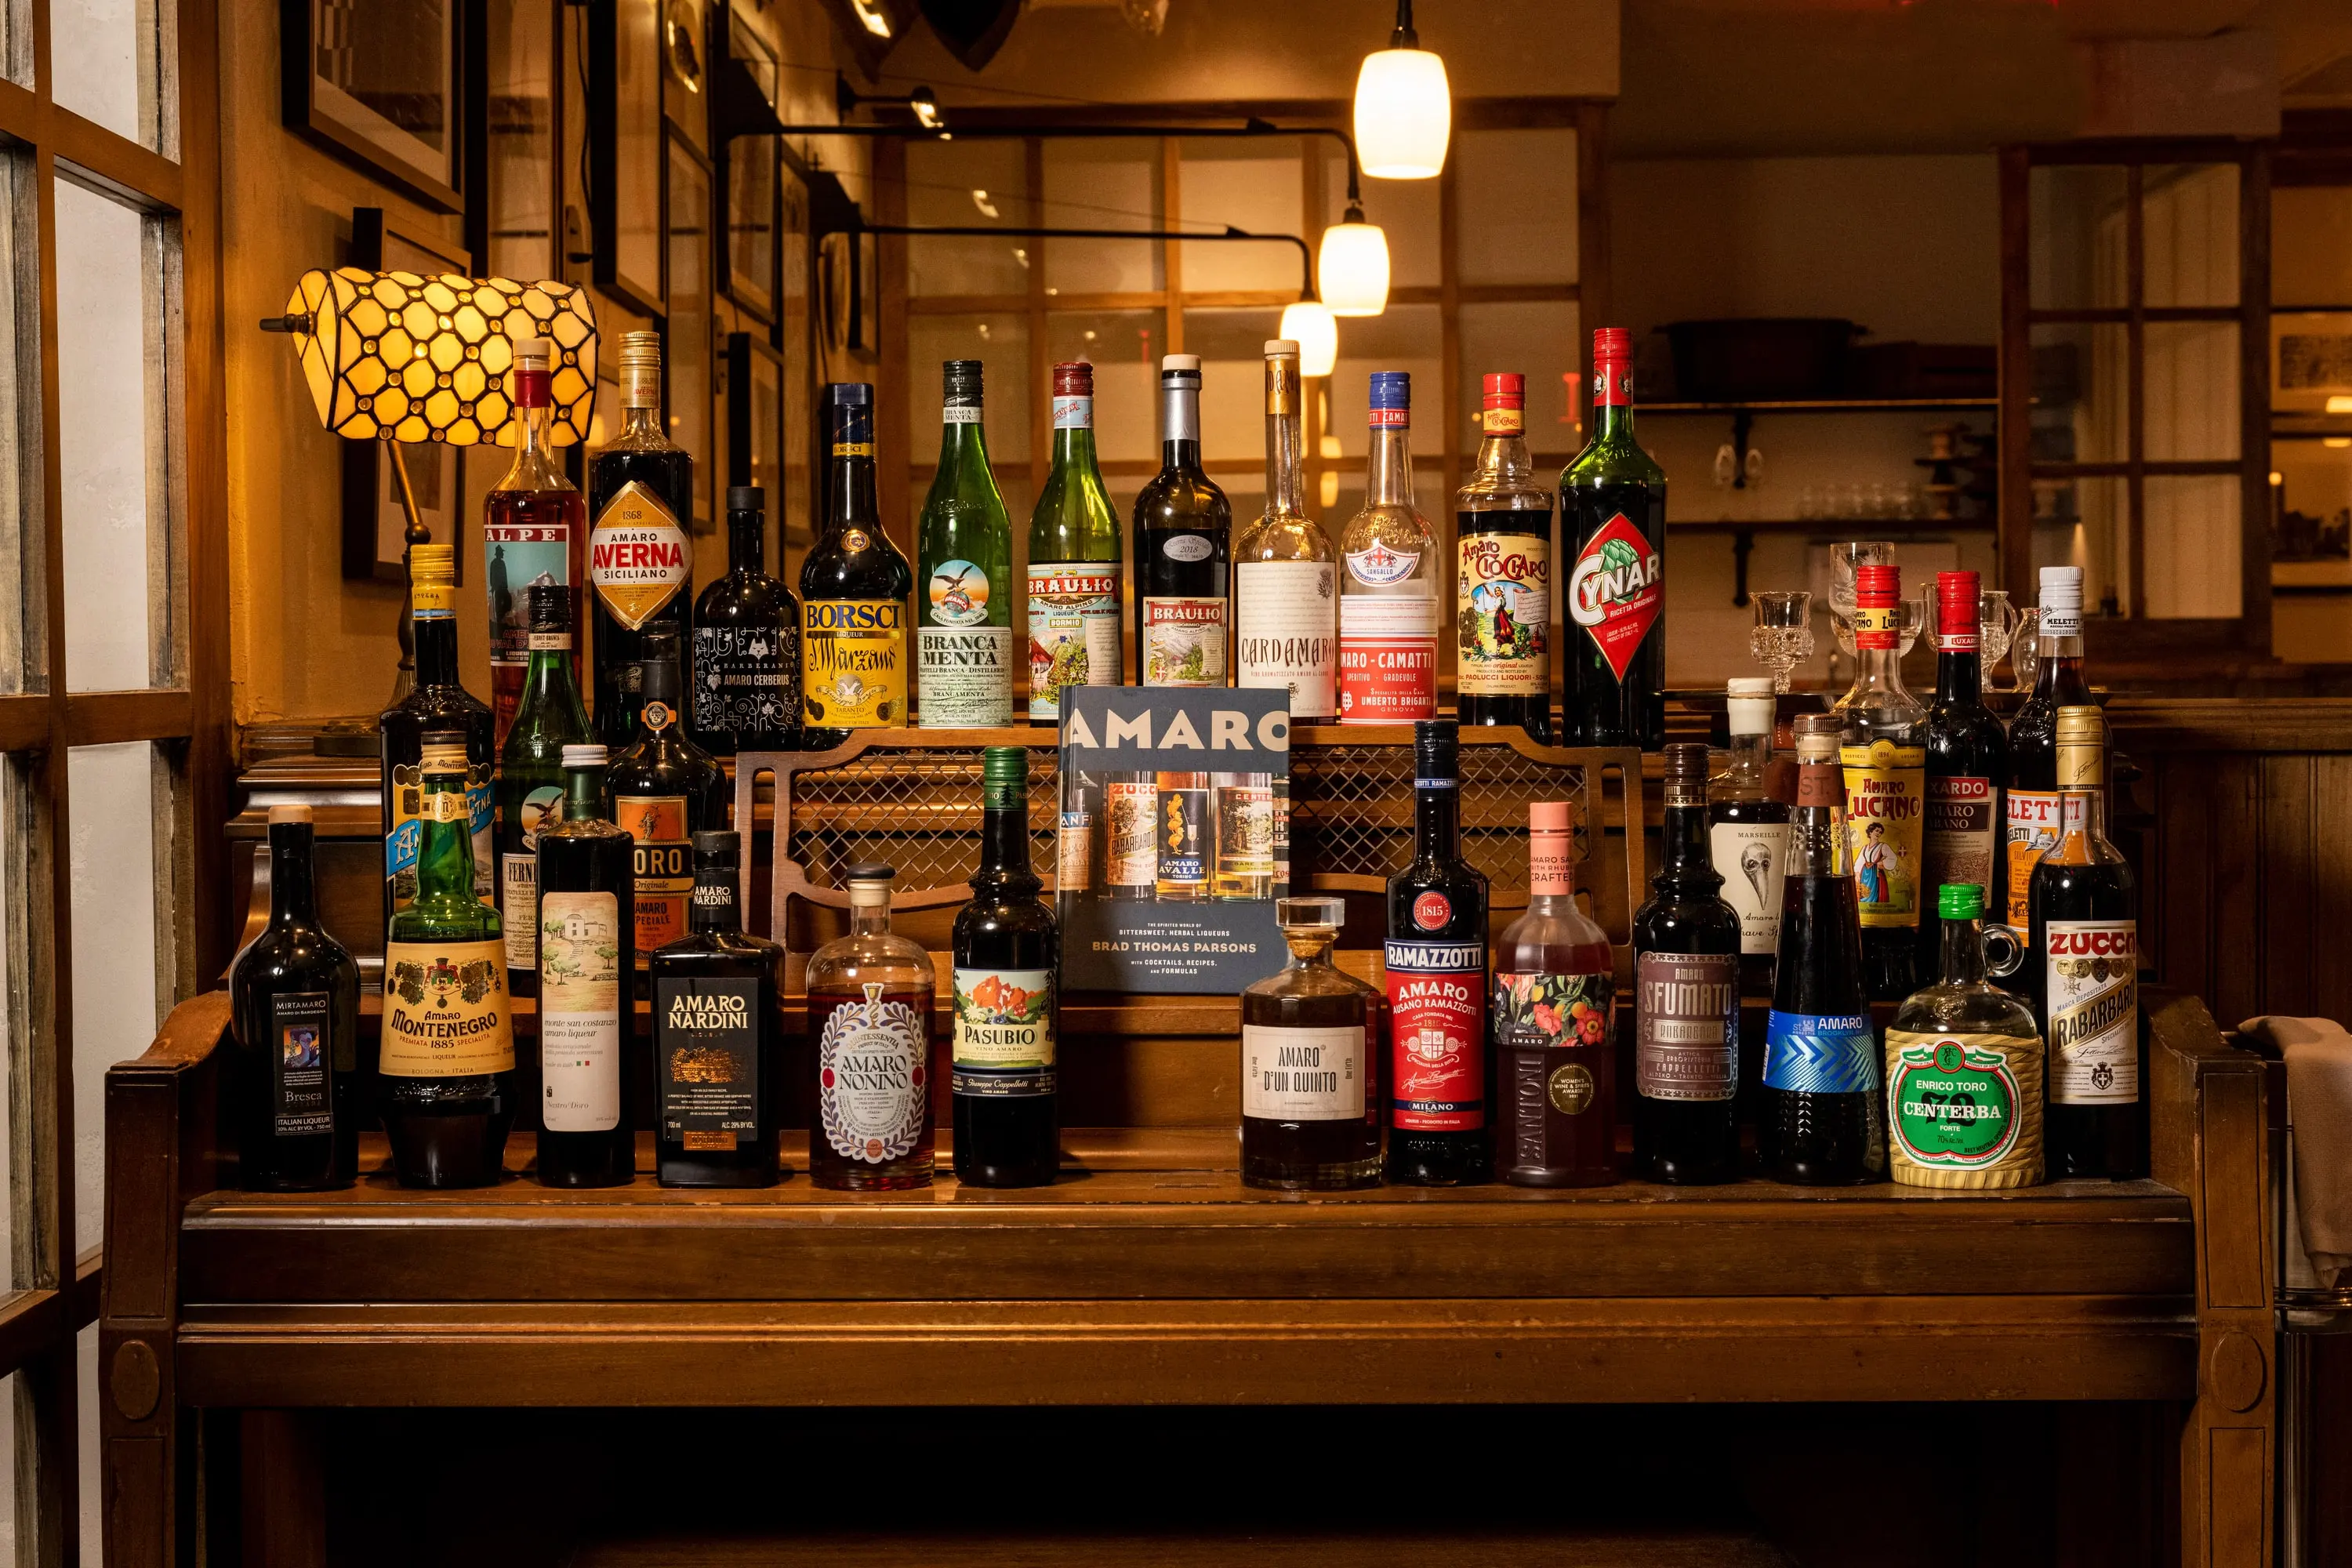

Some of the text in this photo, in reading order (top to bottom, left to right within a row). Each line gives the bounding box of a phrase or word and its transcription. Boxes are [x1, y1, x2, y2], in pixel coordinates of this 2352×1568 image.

[622, 511, 642, 520] 1868
[486, 529, 556, 541] ALPE
[611, 533, 657, 542] AMARO
[593, 543, 684, 570] AVERNA
[604, 570, 667, 579] SICILIANO
[1570, 552, 1662, 626] CYNAR
[945, 595, 967, 611] BRANCA
[1040, 600, 1093, 610] AMARO ALPINO
[1610, 593, 1657, 618] RICETTA ORIGINALE
[806, 605, 899, 628] BORSCI
[924, 636, 997, 650] BRANCA
[924, 652, 997, 665] MENTA
[1242, 638, 1334, 667] CARDAMARO
[1378, 653, 1431, 668] CAMATTI
[724, 675, 789, 685] AMARO CERBERUS
[1361, 697, 1431, 706] UMBERTO BRIGANTI
[1063, 708, 1290, 752] AMARO
[1801, 776, 1830, 795] ST.
[1863, 778, 1905, 795] AMARO
[1843, 788, 1920, 821] LUCANO
[2014, 851, 2033, 860] SILVIO
[1159, 866, 1205, 875] AVALLE
[634, 881, 669, 890] Originale
[695, 886, 730, 896] AMARO
[694, 896, 731, 905] NARDINI
[635, 902, 666, 914] AMARO
[1422, 906, 1443, 916] 1815
[1093, 942, 1256, 953] BRAD THOMAS PARSONS
[1388, 946, 1482, 967] RAMAZZOTTI
[1675, 968, 1704, 980] AMARO
[1399, 981, 1468, 1001] AMARO
[2057, 982, 2107, 1013] MARCA DEPOSITATA
[671, 995, 745, 1012] AMARO
[1645, 981, 1731, 1015] SFUMATO
[276, 1000, 326, 1010] MIRTAMARO
[1393, 999, 1477, 1016] AUSANO RAMAZZOTTI
[425, 1011, 461, 1020] AMARO
[668, 1012, 748, 1029] NARDINI
[2057, 980, 2135, 1049] RABARBARO
[391, 1009, 497, 1038] MONTENEGRO
[583, 1019, 617, 1027] costanzo
[1818, 1017, 1862, 1030] AMARO
[568, 1029, 597, 1039] liqueur
[965, 1025, 1035, 1045] PASUBIO
[1661, 1024, 1718, 1040] RABARBARO
[399, 1036, 454, 1049] PREMIATA 1885
[848, 1033, 900, 1049] QUINTESSENTIA
[1279, 1047, 1319, 1067] AMARO
[1443, 1057, 1455, 1067] DITTA
[840, 1055, 907, 1073] AMARO
[1657, 1063, 1720, 1073] CAPPELLETTI
[839, 1073, 908, 1091] NONINO
[967, 1078, 1029, 1088] Giuseppe Cappelletti
[1294, 1072, 1336, 1093] QUINTO
[1916, 1080, 1987, 1091] ENRICO TORO
[285, 1091, 322, 1102] Bresca
[1519, 1060, 1543, 1159] SANTONI
[1904, 1101, 2002, 1119] CENTERBA
[303, 1116, 330, 1125] LIQUEUR
[1938, 1135, 1948, 1143] 70%
[1976, 1140, 1996, 1152] NEUTRAL
[1982, 1150, 1999, 1160] Casauria
